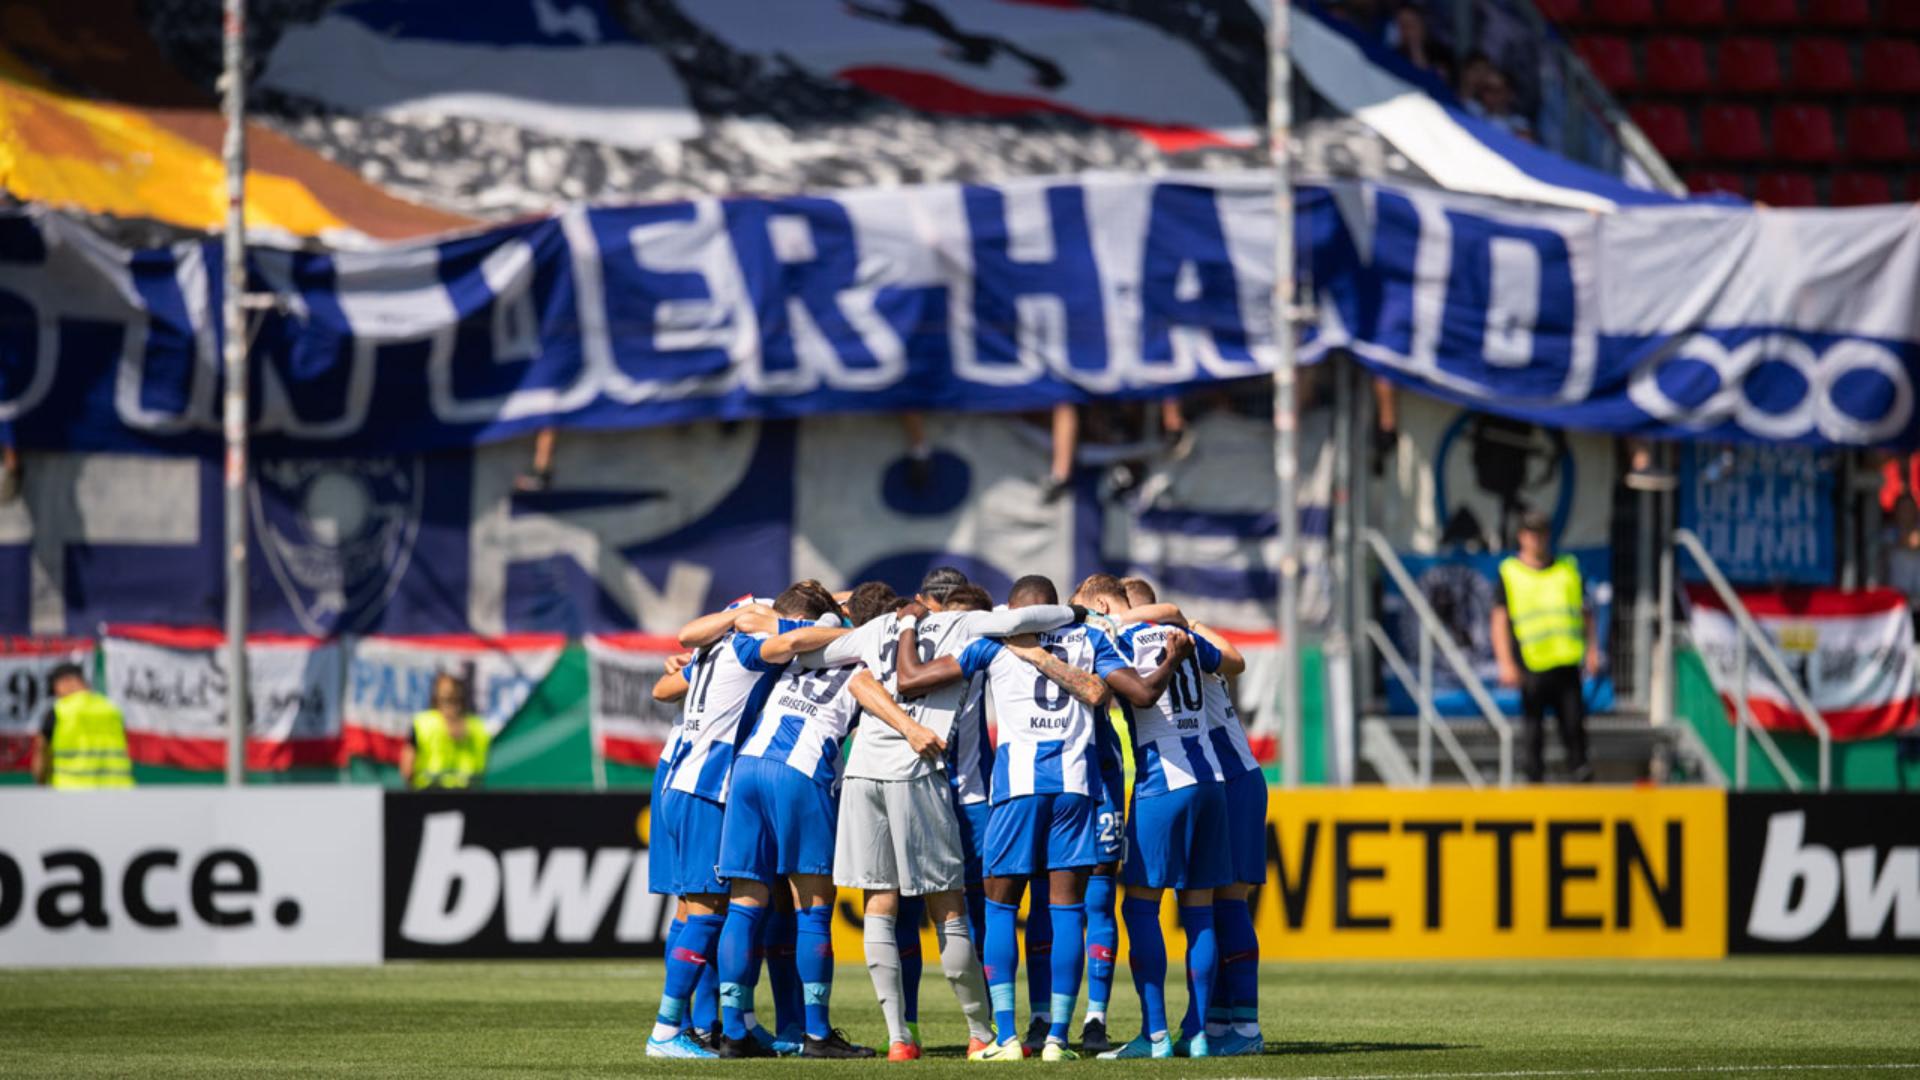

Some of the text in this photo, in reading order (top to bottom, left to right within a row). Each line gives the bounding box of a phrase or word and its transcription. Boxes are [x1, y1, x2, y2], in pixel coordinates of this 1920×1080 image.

[428, 195, 908, 424] DER
[946, 180, 1600, 405] HAND
[1030, 717, 1069, 729] KALOU
[1099, 811, 1124, 841] 25
[400, 810, 681, 945] bwi
